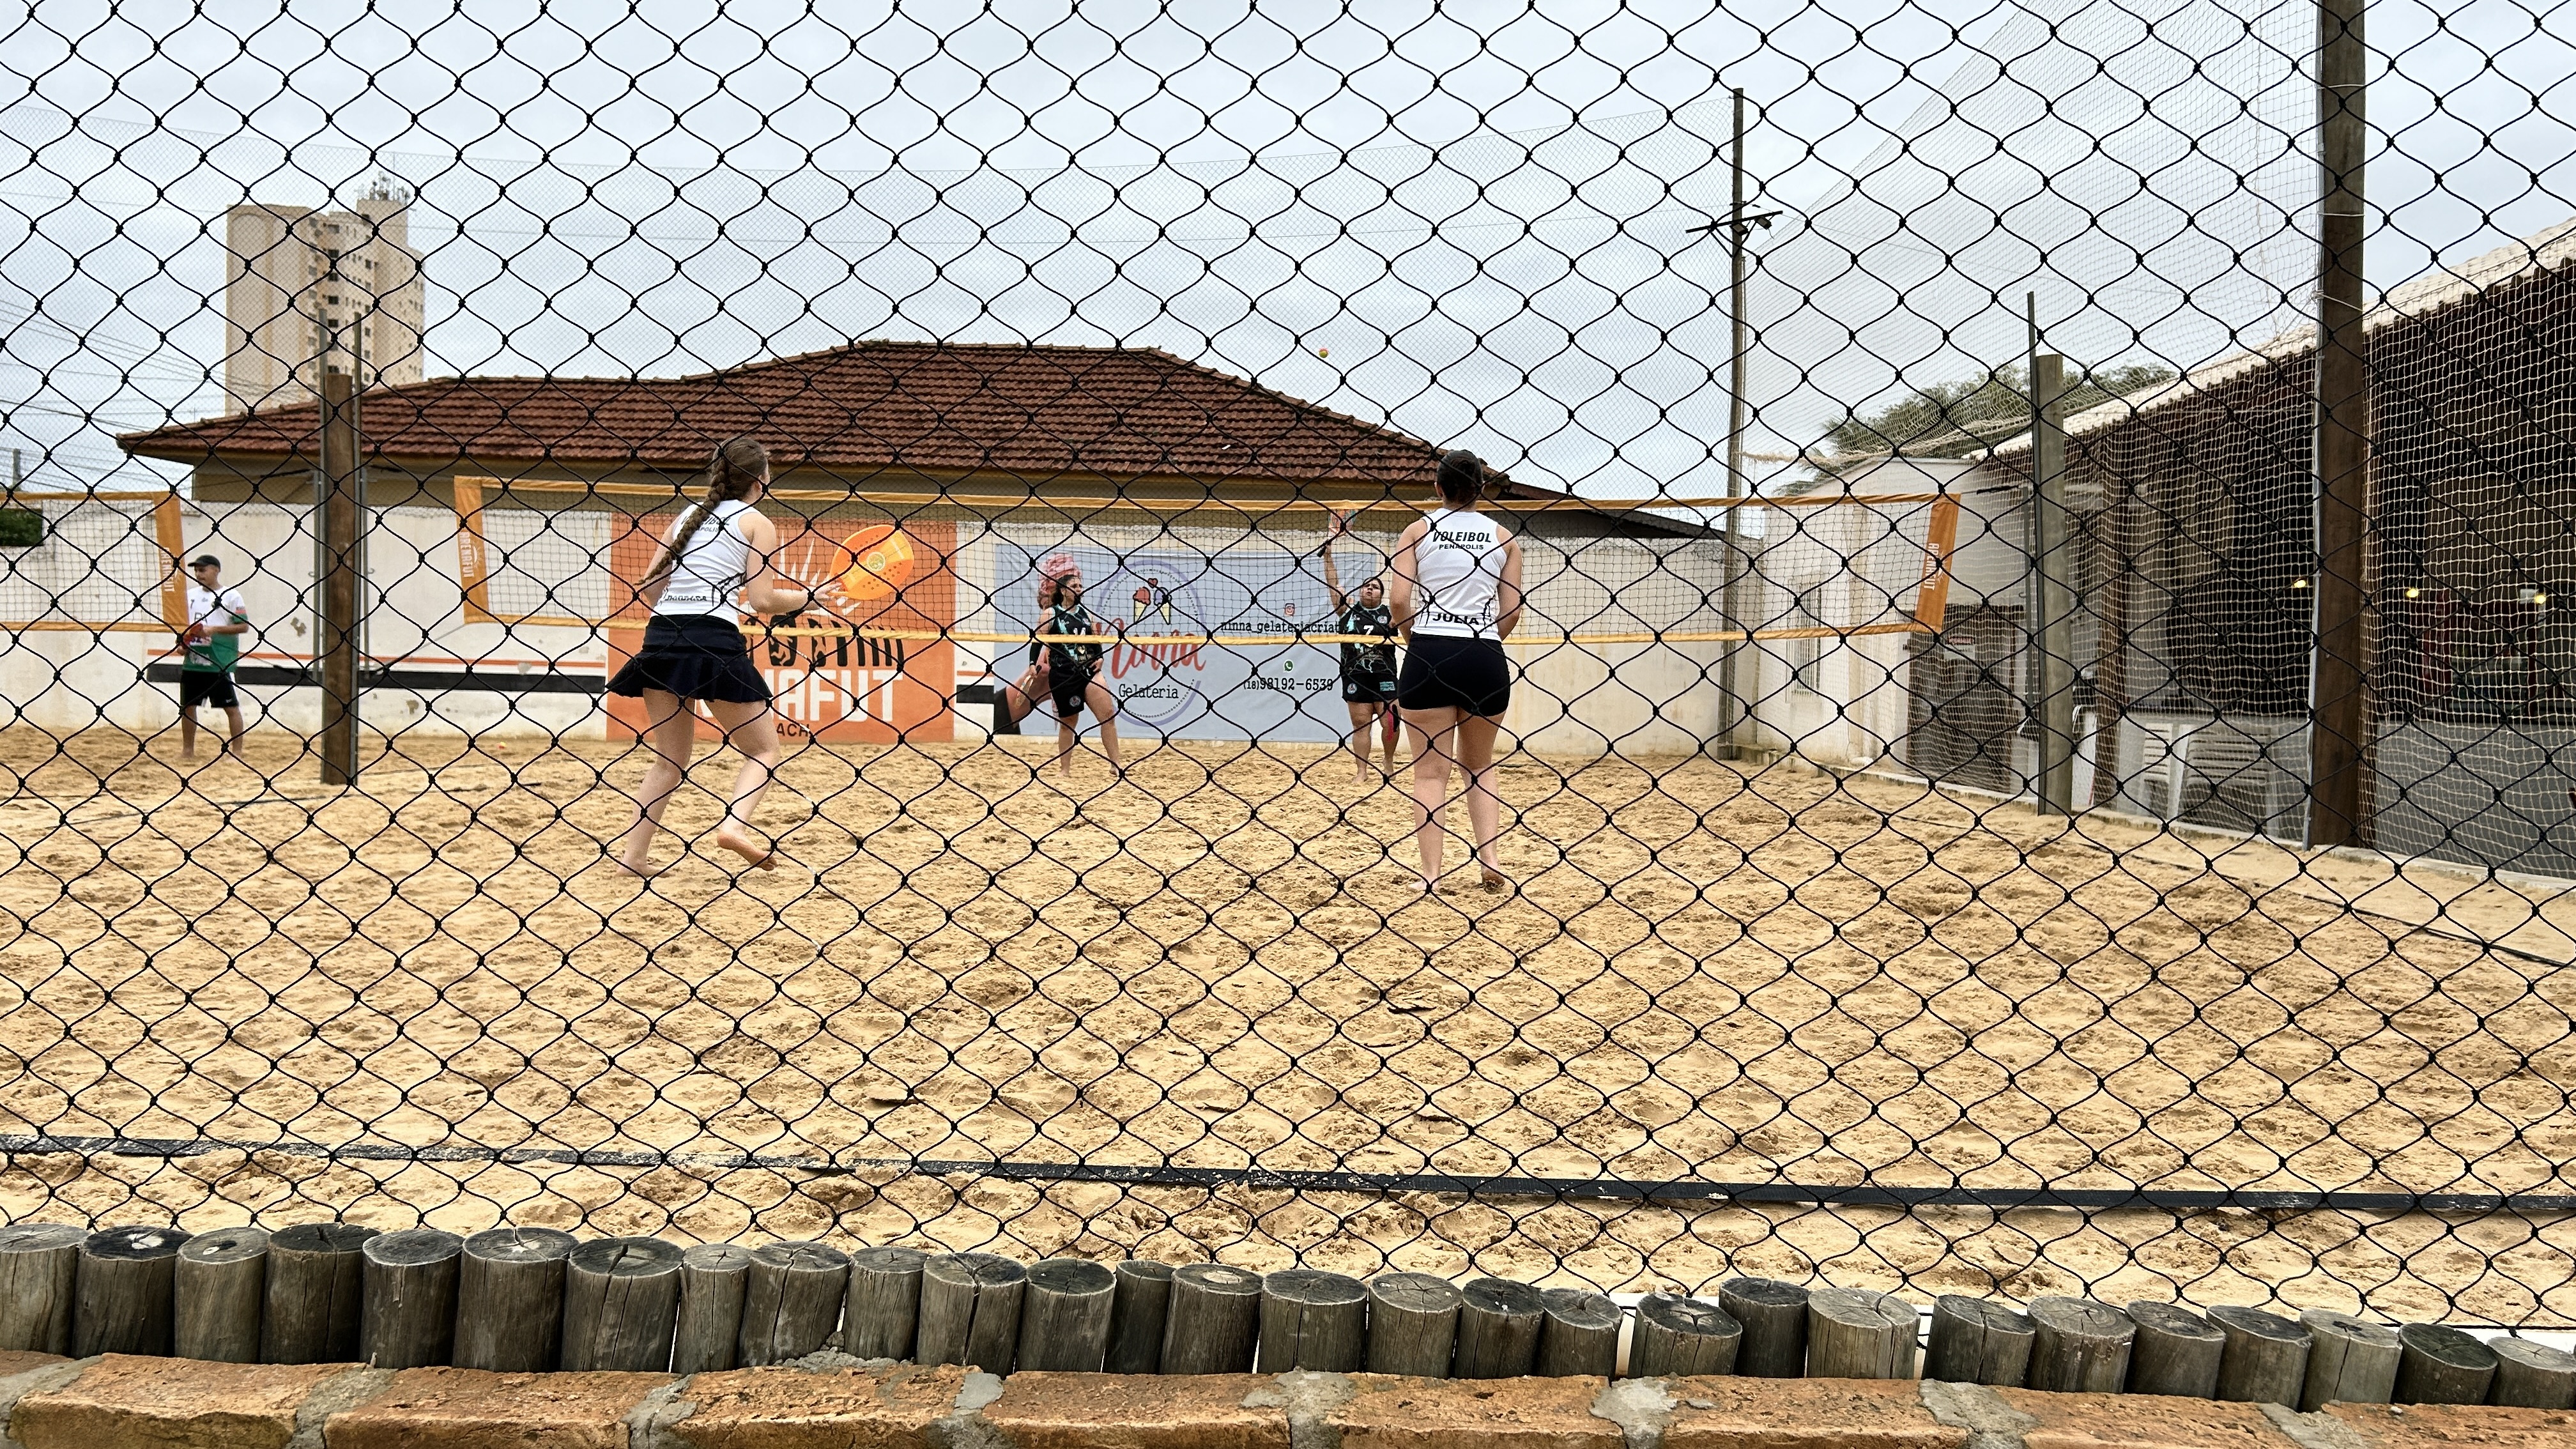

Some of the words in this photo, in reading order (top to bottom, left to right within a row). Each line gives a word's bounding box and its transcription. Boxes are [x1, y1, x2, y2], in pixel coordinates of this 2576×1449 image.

[1433, 532, 1491, 542] VOLEIBOL
[1432, 613, 1480, 625] JULIA
[1119, 684, 1179, 698] Gelateria
[776, 723, 809, 737] ACH
